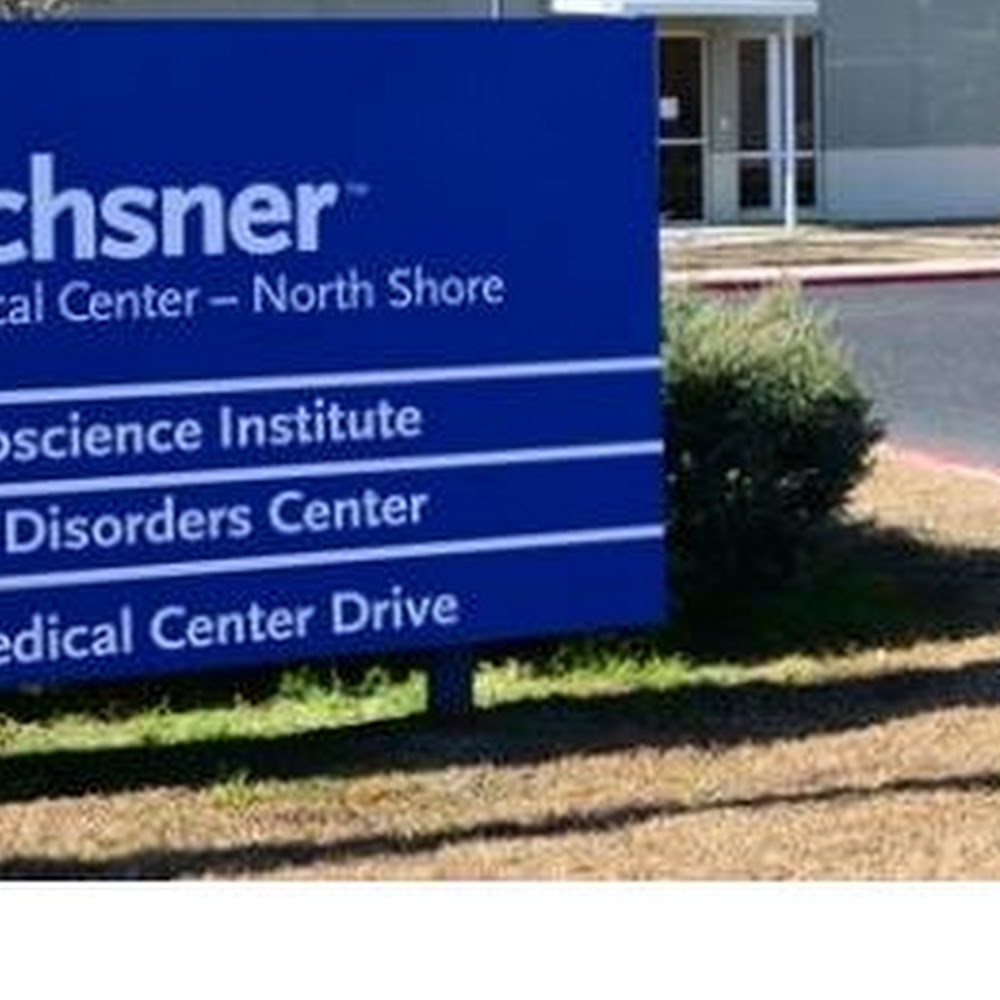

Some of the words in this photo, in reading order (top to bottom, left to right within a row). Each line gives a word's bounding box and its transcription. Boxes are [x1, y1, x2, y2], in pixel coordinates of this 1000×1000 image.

[58, 280, 198, 322] Center
[253, 268, 374, 313] North
[388, 265, 504, 307] Shore
[220, 397, 422, 447] Institute
[5, 495, 252, 553] Disorders
[268, 490, 428, 534] Center
[150, 603, 314, 649] Center
[332, 586, 458, 634] Drive
